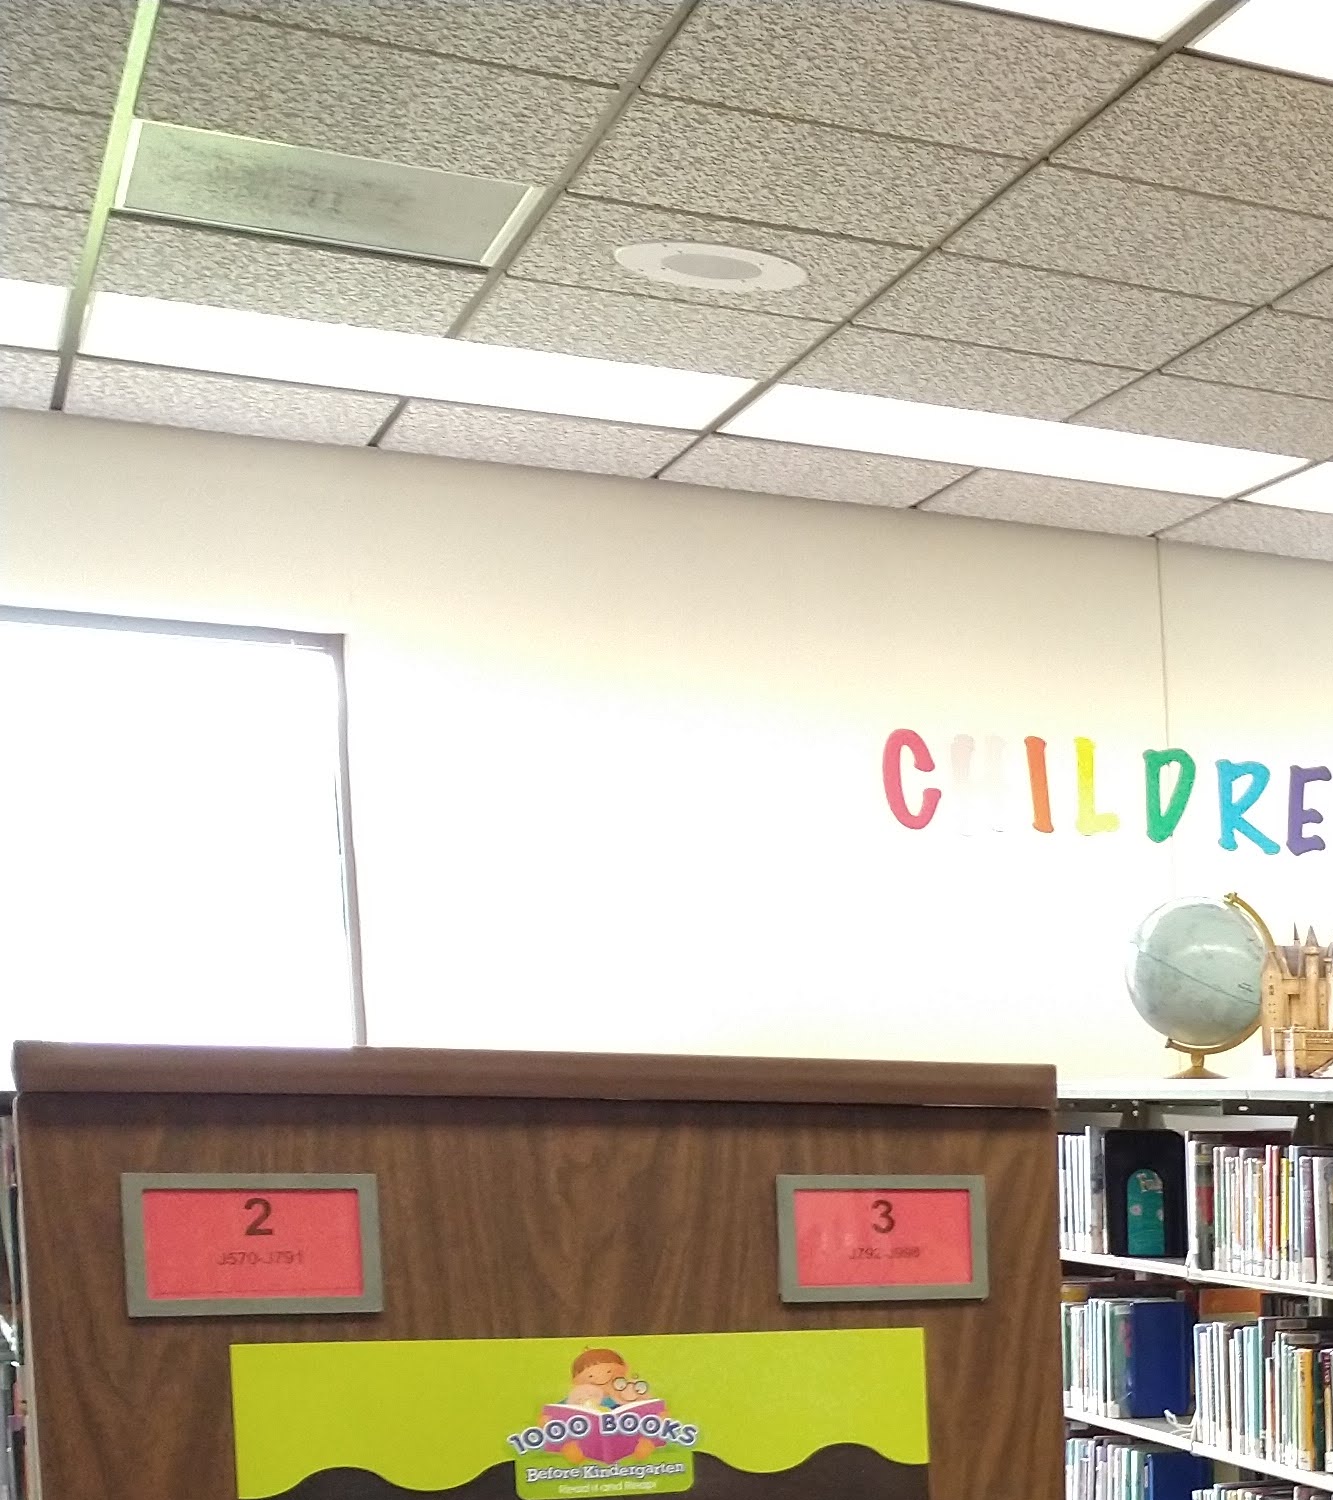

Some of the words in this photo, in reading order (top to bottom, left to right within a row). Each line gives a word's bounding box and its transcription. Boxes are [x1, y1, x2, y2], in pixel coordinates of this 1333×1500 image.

[244, 1198, 273, 1235] 2
[872, 1200, 896, 1233] 3
[508, 1415, 590, 1455] 1000
[600, 1412, 699, 1446] BOOKS
[526, 1466, 583, 1482] Before
[583, 1462, 685, 1480] Kindergarten
